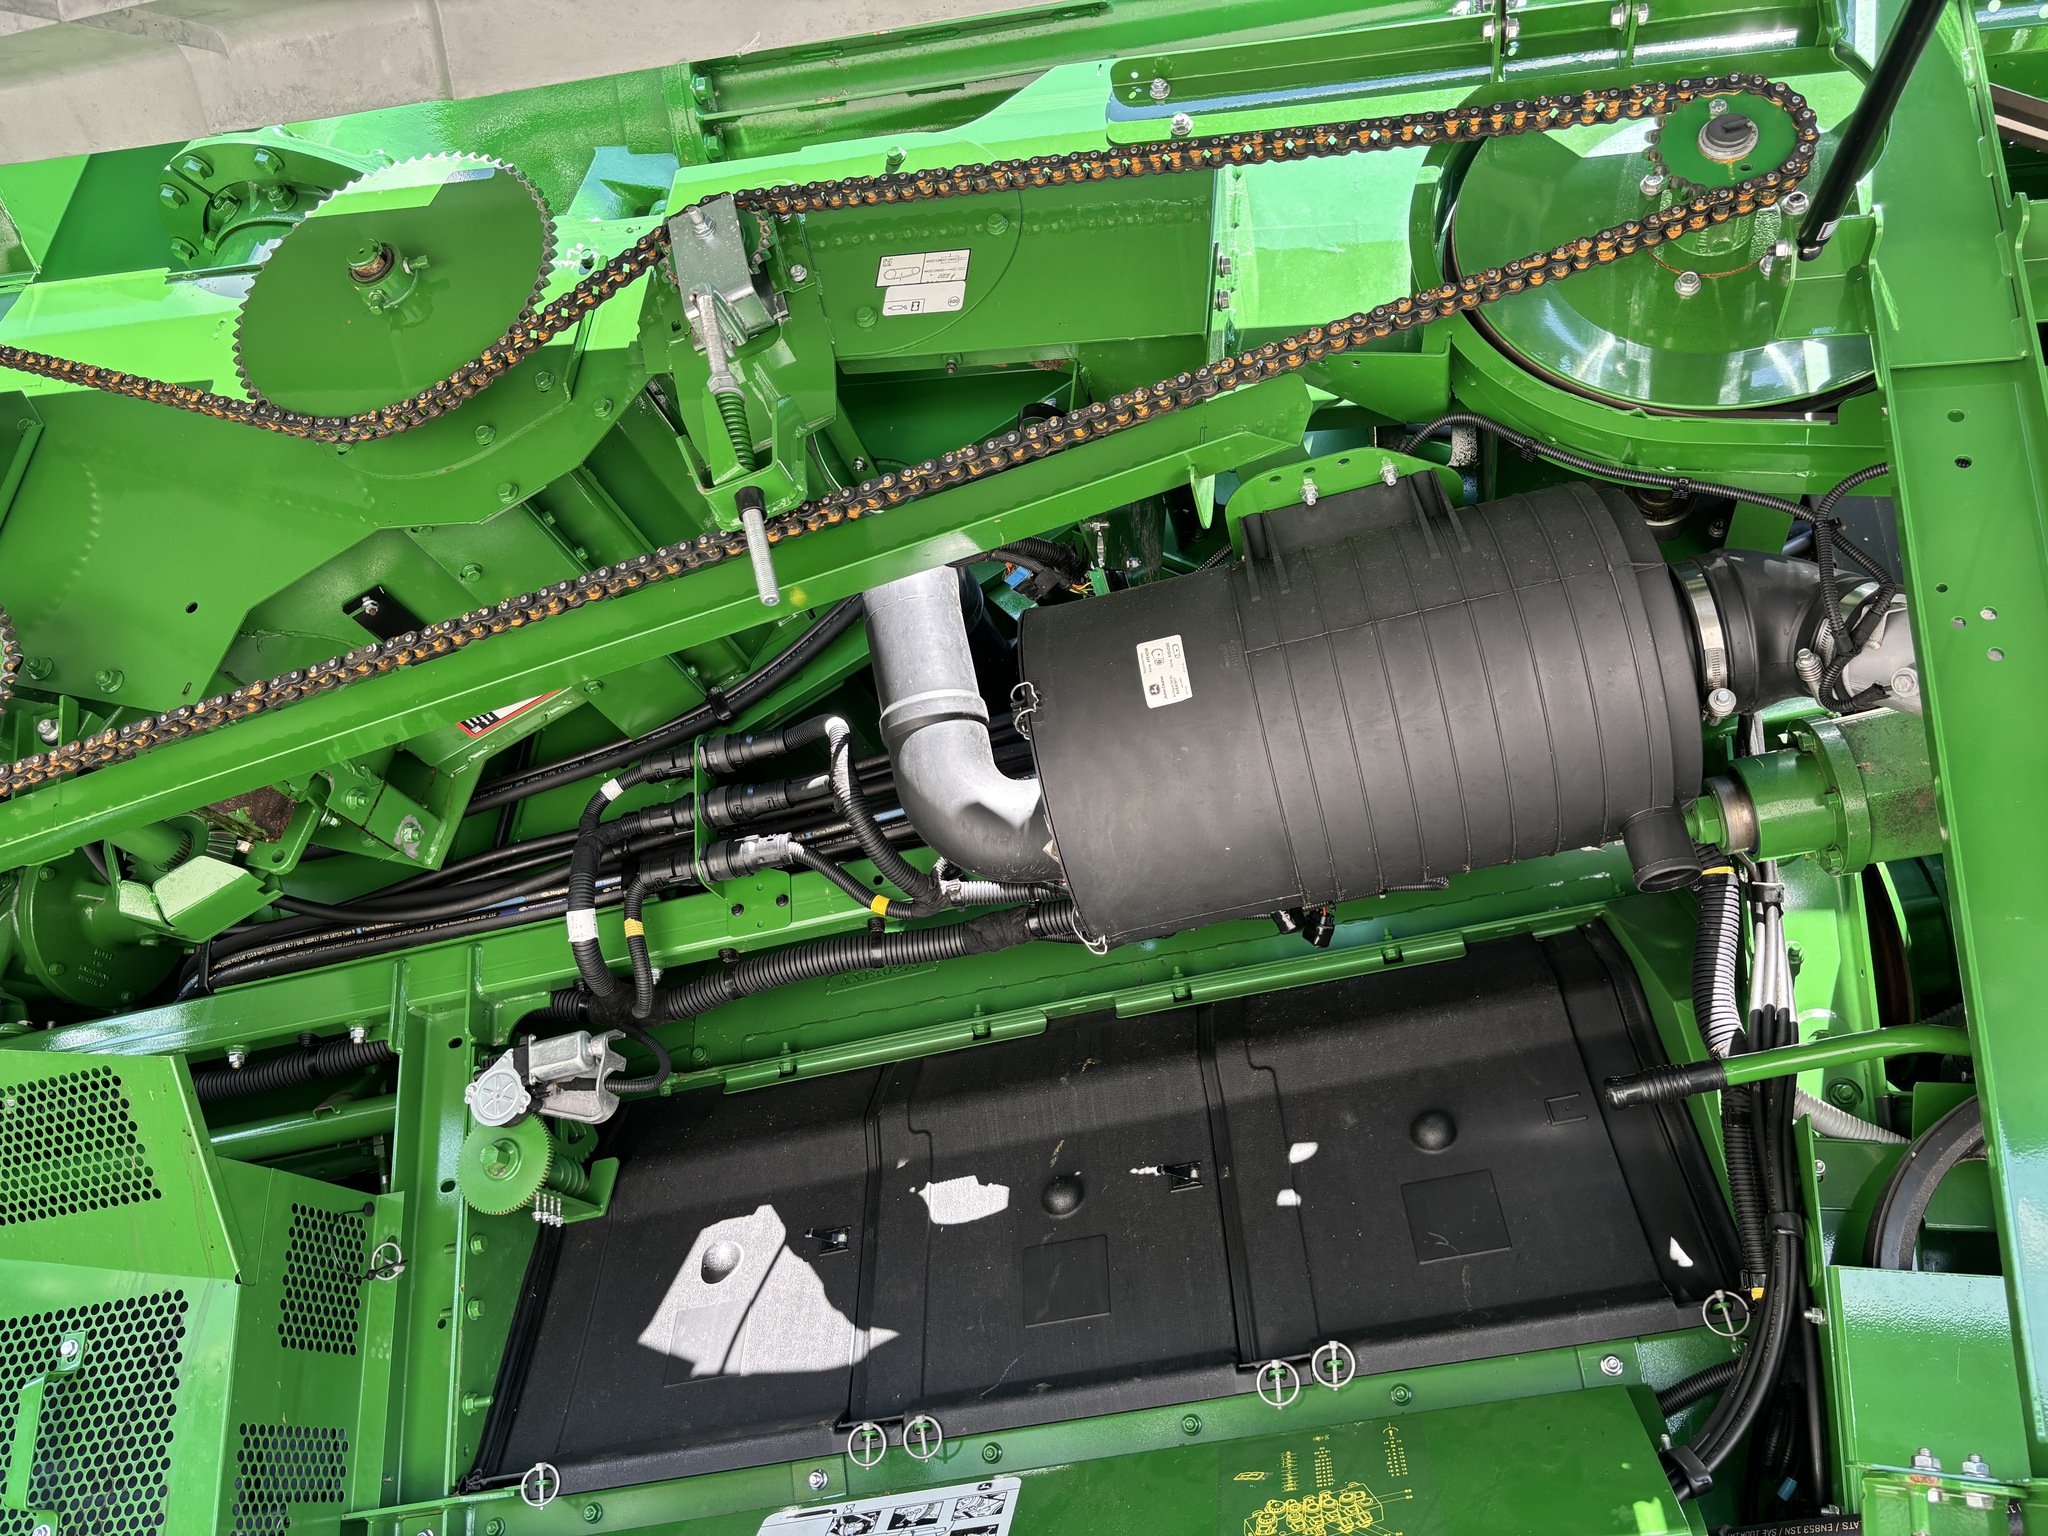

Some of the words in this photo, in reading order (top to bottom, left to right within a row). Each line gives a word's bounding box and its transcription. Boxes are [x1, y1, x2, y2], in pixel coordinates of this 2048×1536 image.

[1784, 1525, 1802, 1535] 1SN
[1803, 1523, 1833, 1533] EN853
[1842, 1520, 1862, 1531] ATS
